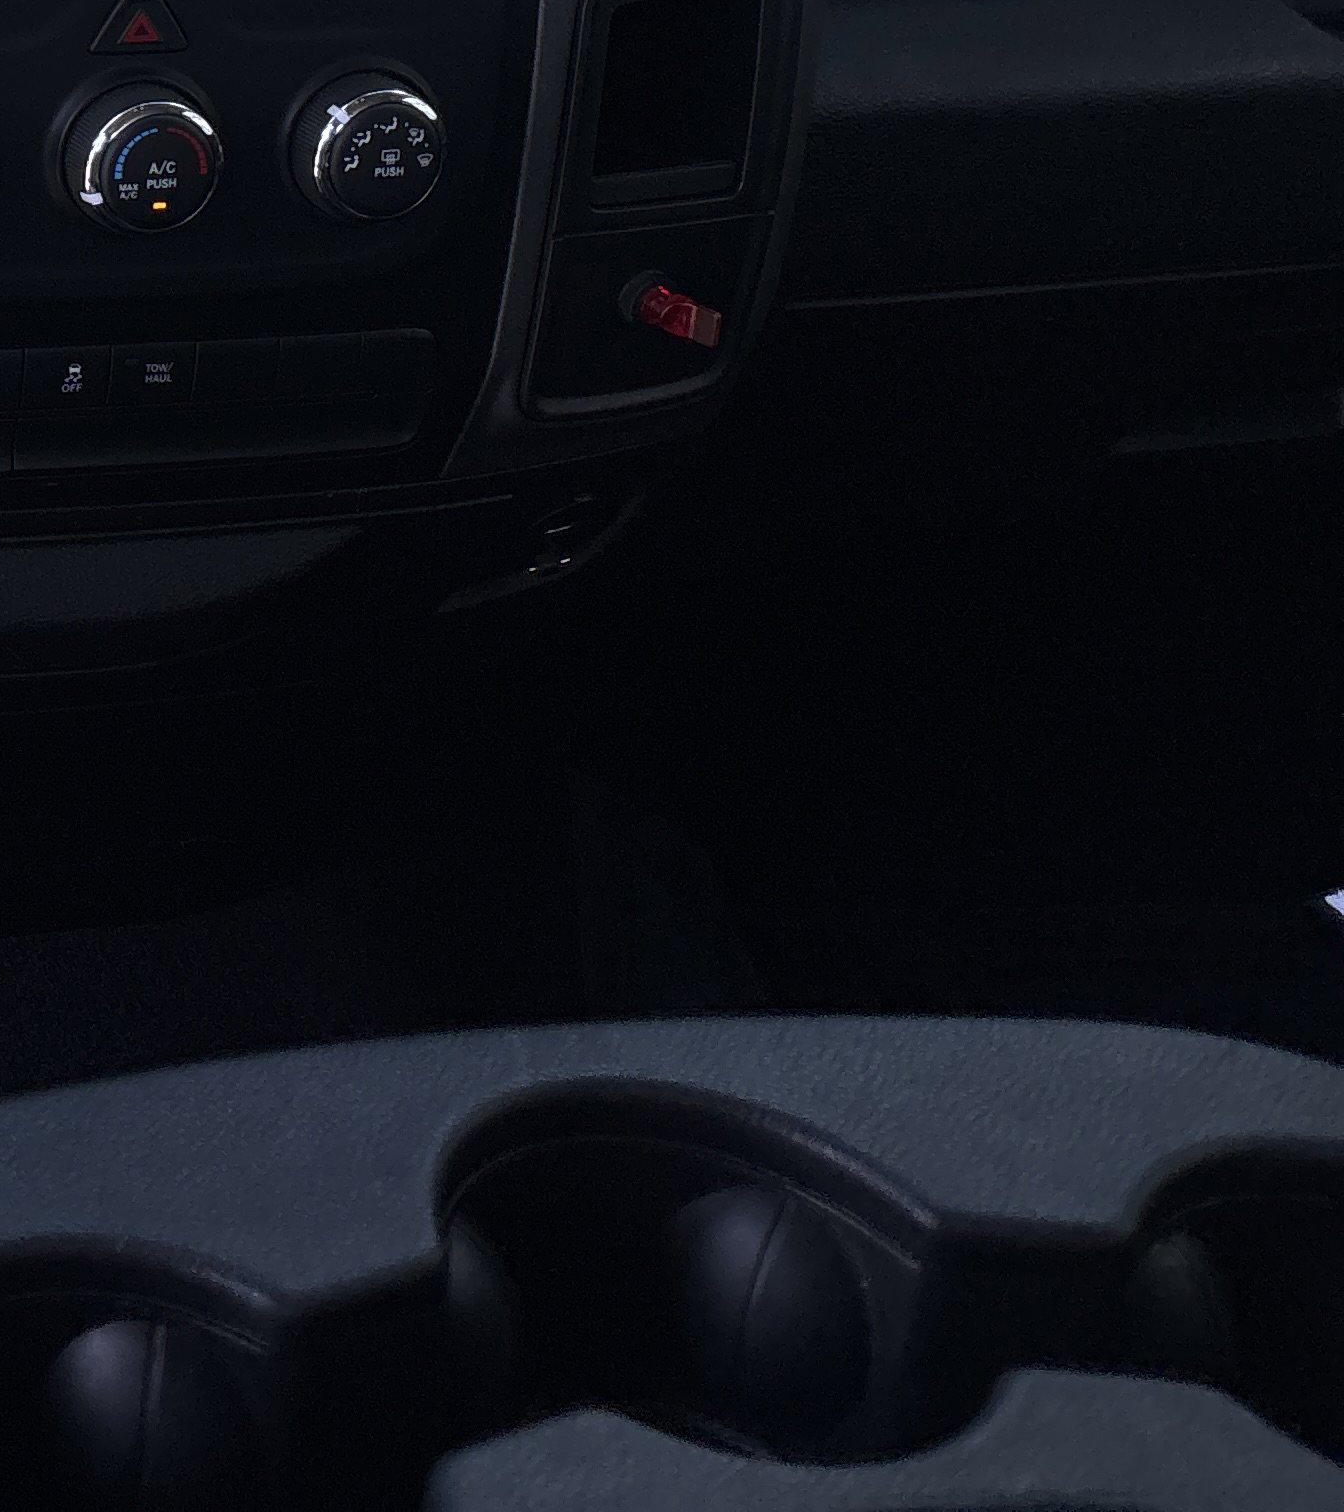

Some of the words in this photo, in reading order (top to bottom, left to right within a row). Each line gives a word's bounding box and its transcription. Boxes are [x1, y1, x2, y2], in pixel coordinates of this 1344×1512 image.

[148, 159, 177, 176] A/C
[374, 166, 405, 178] PUSH
[118, 183, 139, 192] MAX
[146, 177, 177, 189] PUSH
[119, 190, 138, 200] A/C
[144, 373, 173, 384] HAUL
[61, 383, 83, 393] OFF
